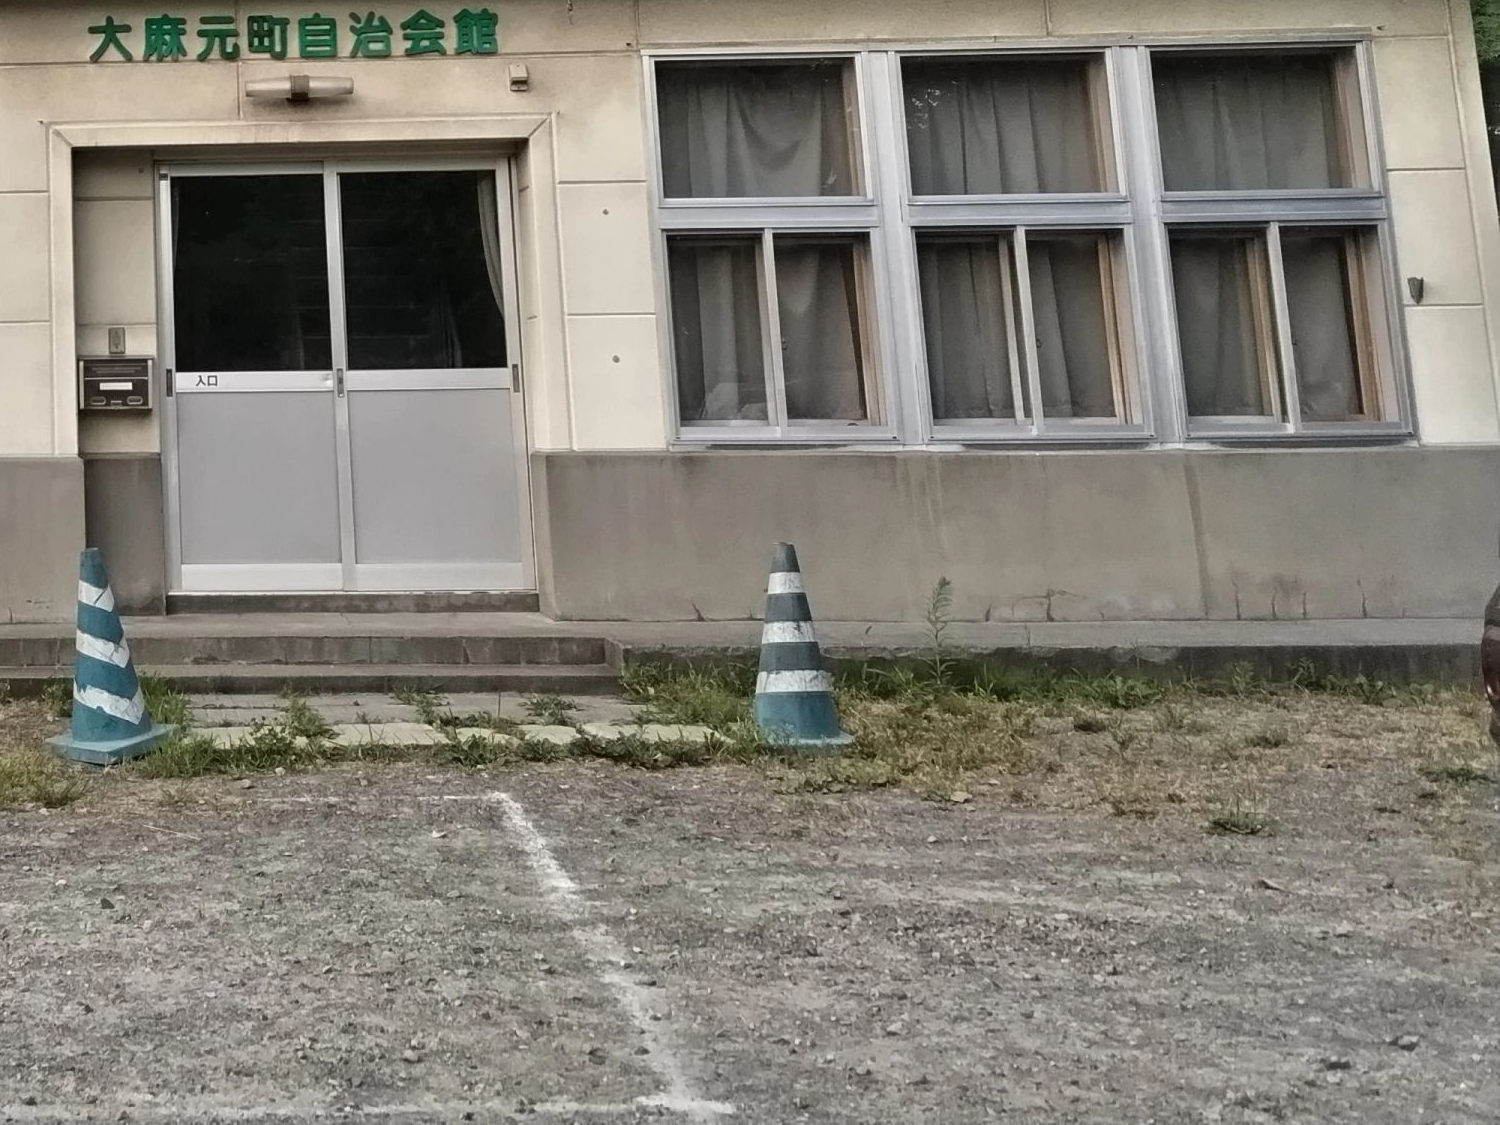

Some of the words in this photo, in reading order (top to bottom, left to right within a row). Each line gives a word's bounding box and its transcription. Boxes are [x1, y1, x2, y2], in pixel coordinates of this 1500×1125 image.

[87, 7, 499, 62] 大麻元町自治会館
[195, 374, 218, 387] 入口
